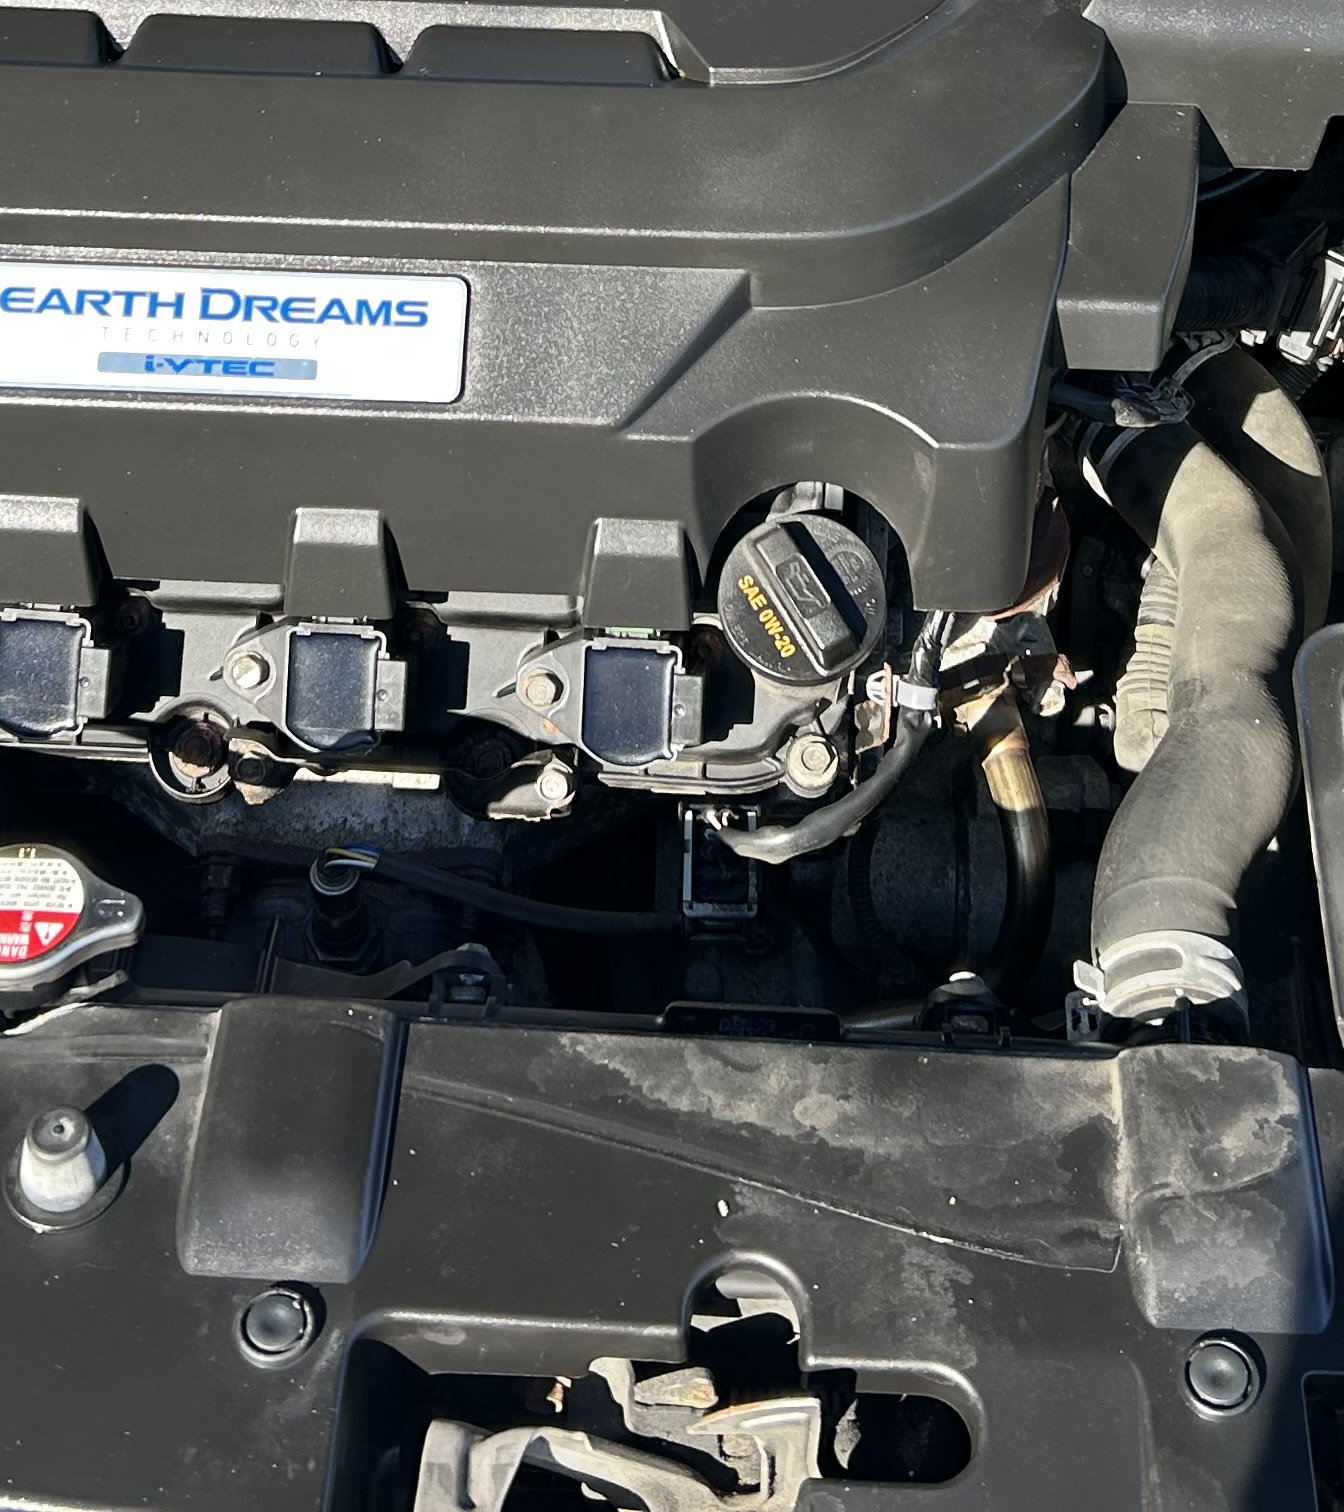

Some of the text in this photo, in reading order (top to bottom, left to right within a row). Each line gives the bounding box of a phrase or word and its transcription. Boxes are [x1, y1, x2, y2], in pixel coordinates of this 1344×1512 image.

[199, 286, 429, 328] DREAMS
[101, 325, 321, 349] TECHNOLOGY
[143, 352, 276, 377] i-VTEC
[738, 575, 768, 611] SAE
[758, 605, 796, 658] 0W-20
